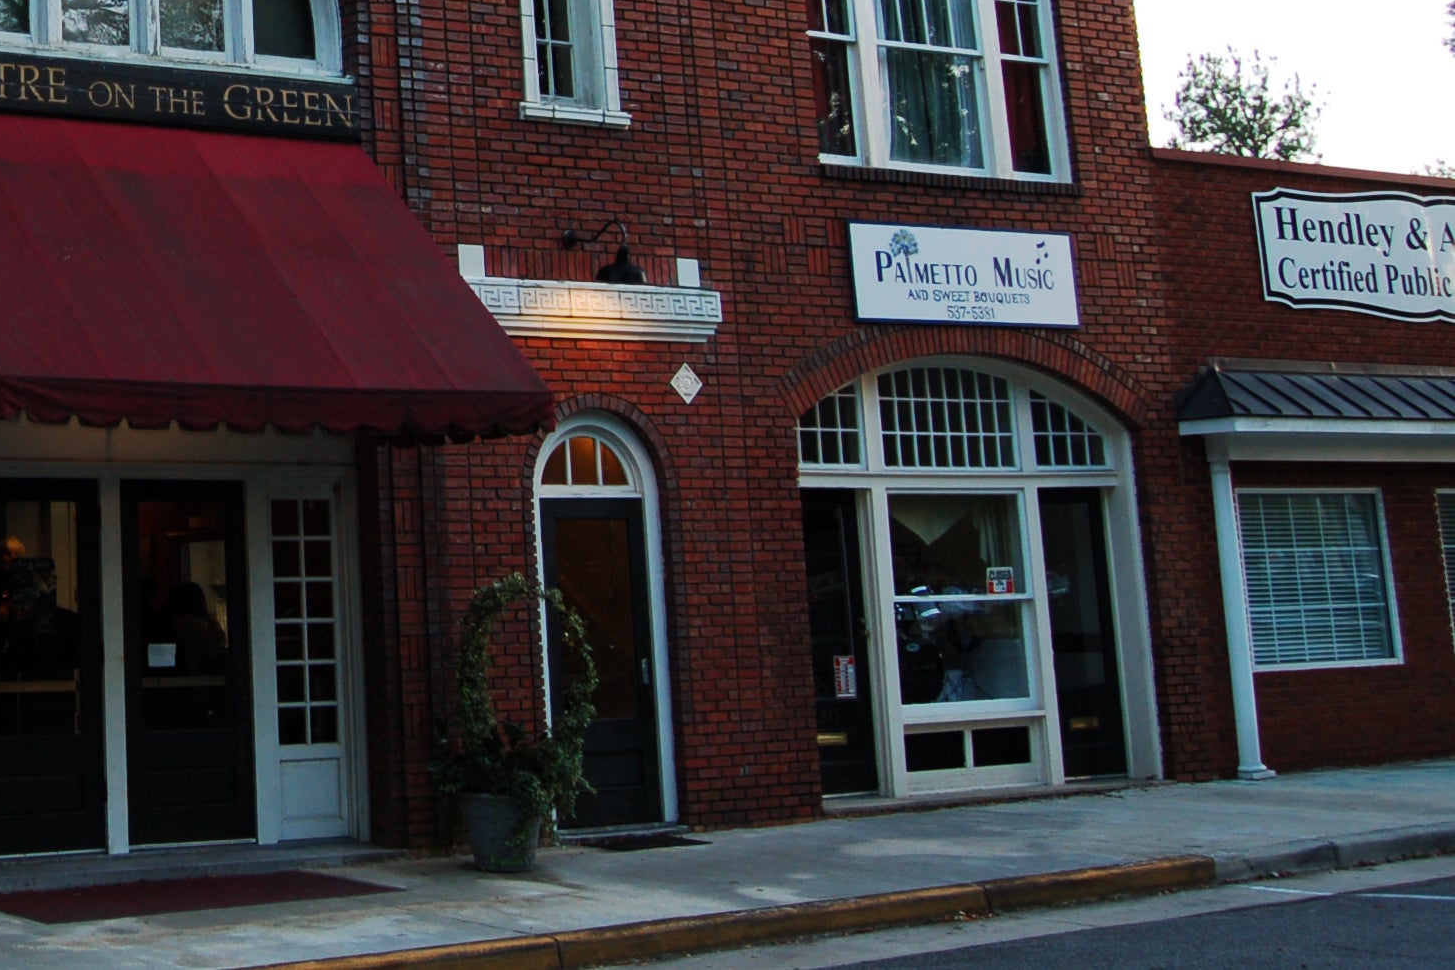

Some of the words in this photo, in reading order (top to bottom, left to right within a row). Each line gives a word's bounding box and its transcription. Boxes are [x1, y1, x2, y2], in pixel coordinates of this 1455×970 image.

[88, 80, 136, 111] ON
[148, 85, 205, 115] THE
[223, 83, 353, 127] GREEN
[1273, 206, 1394, 257] Hendley
[1406, 217, 1428, 251] &
[993, 256, 1054, 290] MUSIC
[1277, 256, 1379, 294] Certified
[1383, 264, 1453, 298] Public
[907, 289, 929, 302] AND
[933, 289, 970, 303] SWEET
[974, 291, 1031, 305] BOUQUETS
